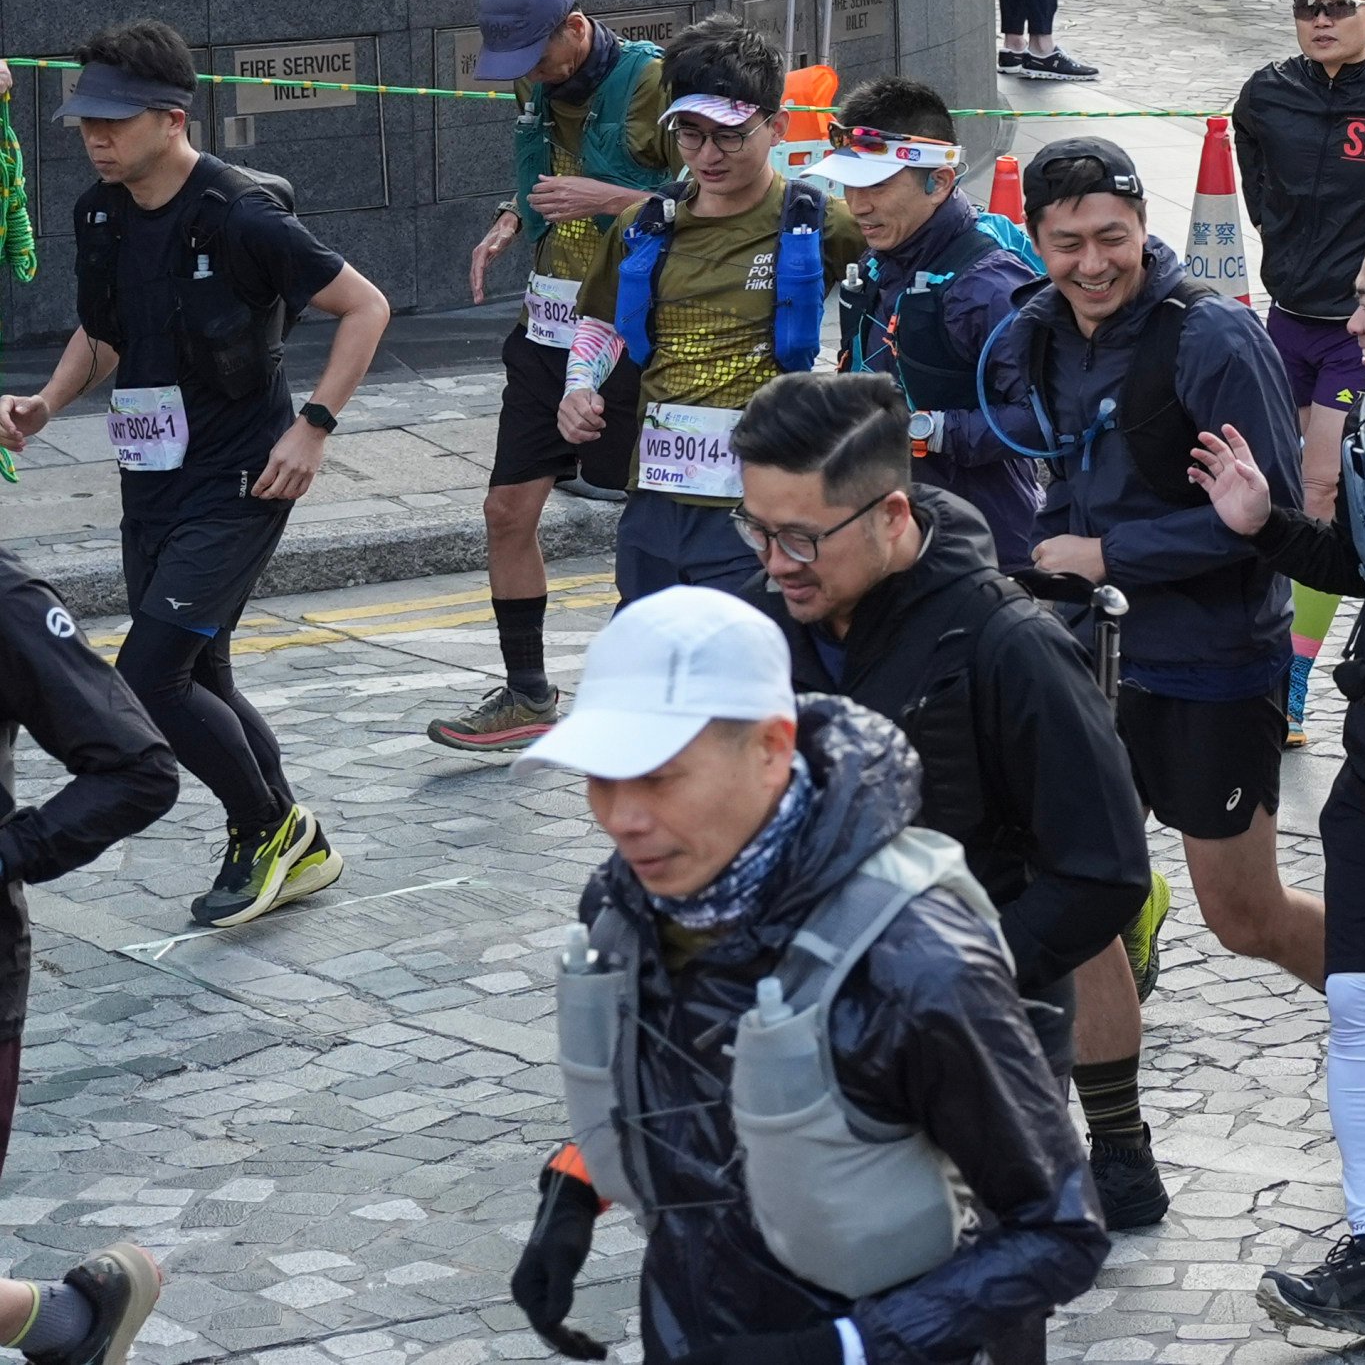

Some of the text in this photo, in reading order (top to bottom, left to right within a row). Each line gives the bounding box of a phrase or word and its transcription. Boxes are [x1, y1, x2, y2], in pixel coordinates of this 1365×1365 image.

[621, 22, 673, 42] SERVICE
[845, 12, 868, 32] INLET
[240, 53, 352, 78] FIRE SERVICE
[1192, 221, 1236, 246] 警察
[111, 414, 176, 441] WT 8024-1
[646, 438, 671, 458] WB
[645, 466, 684, 484] 50km
